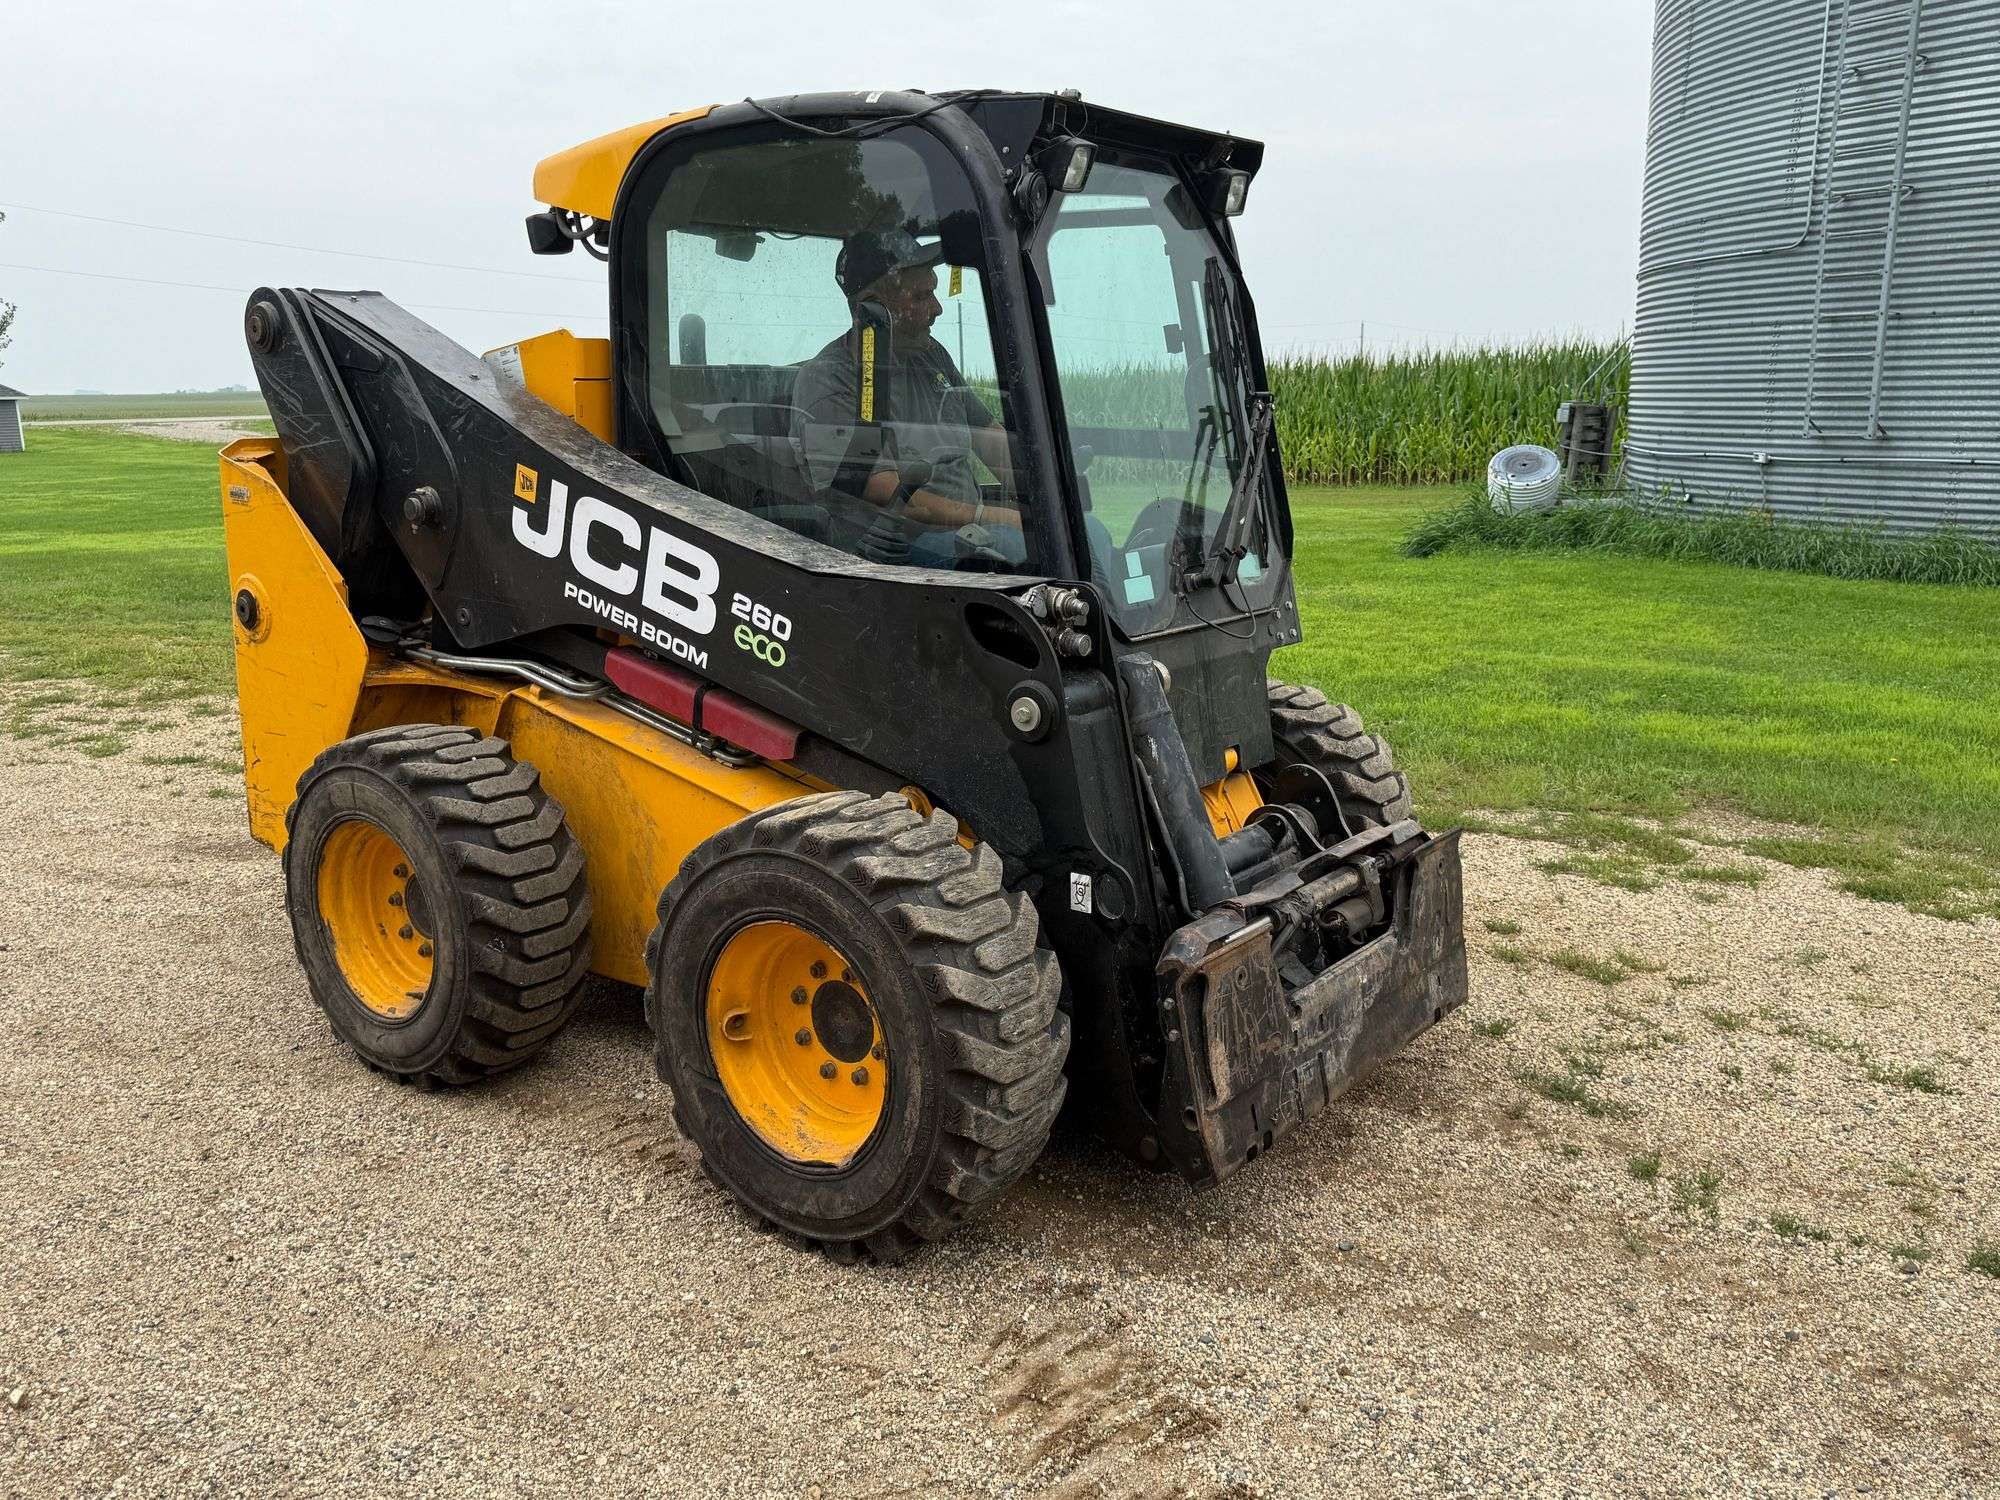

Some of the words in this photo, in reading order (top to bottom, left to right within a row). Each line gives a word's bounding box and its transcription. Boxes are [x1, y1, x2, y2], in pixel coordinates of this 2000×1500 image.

[519, 472, 535, 491] JCB
[512, 479, 719, 634] JCB
[564, 581, 638, 633] POWER
[641, 620, 709, 669] BOOM
[731, 592, 792, 641] 260
[734, 624, 786, 667] eco
